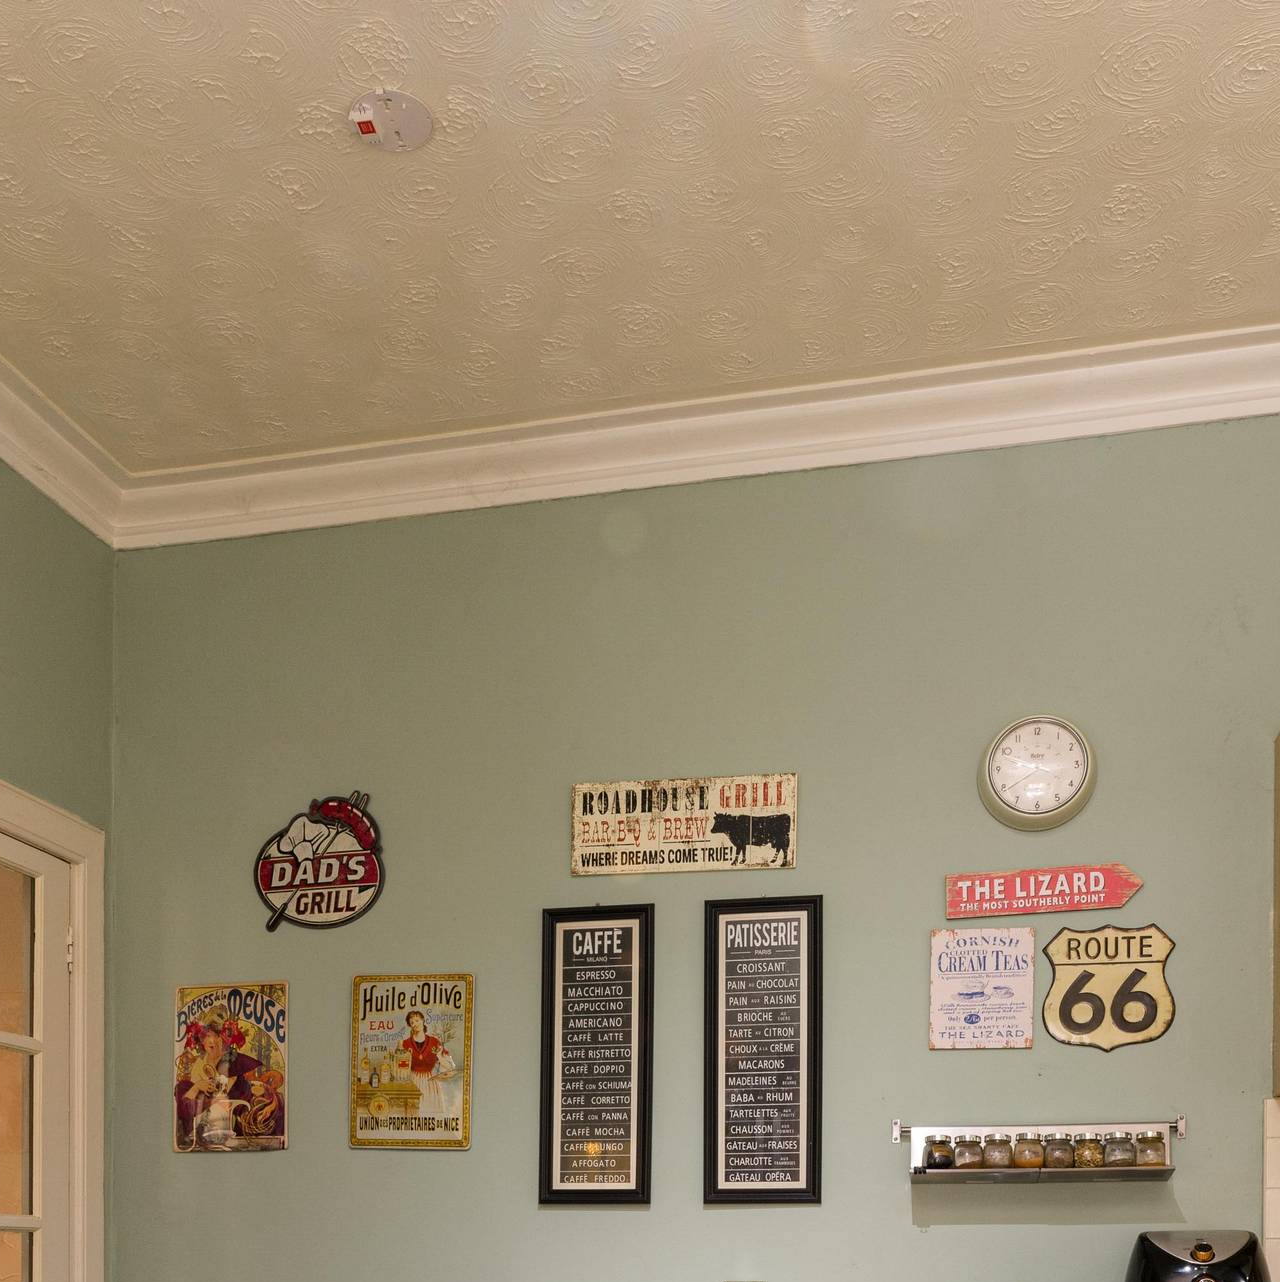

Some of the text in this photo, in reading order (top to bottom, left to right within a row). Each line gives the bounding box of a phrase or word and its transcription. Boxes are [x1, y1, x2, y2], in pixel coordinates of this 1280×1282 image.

[1034, 727, 1041, 736] 12
[1068, 743, 1074, 751] 2
[1074, 760, 1080, 769] 3
[582, 780, 787, 816] ROADHOUSE GRILL
[1055, 793, 1060, 802] 5
[1035, 801, 1040, 809] 6
[647, 818, 657, 841] &
[662, 816, 710, 840] BREW
[581, 846, 733, 867] WHERE DREAMS COME TRUE!
[271, 855, 366, 887] DAD'S
[958, 871, 1106, 901] THE LIZARD
[295, 889, 357, 916] GRILL
[960, 893, 1106, 911] THE MOST SOUTHERLY POINT
[727, 921, 799, 948] PATISSERIE
[572, 928, 623, 955] CAFFÈ
[945, 936, 1020, 949] CORNISH
[1067, 935, 1153, 960] ROUTE
[937, 950, 1029, 973] CREAM TEAS
[736, 962, 786, 973] CROISSANT
[576, 970, 616, 980] ESPRESSO
[727, 980, 746, 990] PAIN
[756, 978, 799, 989] CHOCOLAT
[567, 986, 623, 997] MACCHIATO
[360, 985, 407, 1021] Huile
[729, 997, 748, 1006] PAIN
[763, 994, 797, 1004] RAISINS
[1058, 968, 1158, 1036] 66
[567, 1001, 624, 1012] CAPPUCCINO
[227, 988, 286, 1043] MEUSE
[737, 1012, 773, 1022] BRIOCHE
[369, 1021, 395, 1031] EAU
[568, 1017, 623, 1028] AMERICANO
[598, 1033, 624, 1041] LATTE
[728, 1028, 753, 1038] TARTE
[764, 1027, 794, 1038] CITRON
[939, 1029, 1025, 1039] THE LIZARD
[370, 1045, 388, 1053] EXTRA
[588, 1048, 631, 1058] RISTRETTO
[729, 1045, 758, 1054] CHOUX
[593, 1065, 625, 1074] DOPPIO
[738, 1059, 785, 1070] MACARONS
[598, 1081, 632, 1090] SCHIUMA
[728, 1076, 777, 1086] MADELEINES
[591, 1096, 631, 1105] CORRETTO
[730, 1093, 755, 1103] BABA
[766, 1092, 793, 1101] RHUM
[601, 1112, 629, 1120] PANNA
[729, 1108, 778, 1118] TARTELETTES
[359, 1116, 380, 1131] UNION
[443, 1117, 460, 1132] NICE
[730, 1124, 773, 1134] CHAUSSON
[594, 1127, 625, 1136] MOCHA
[596, 1142, 624, 1151] LUNGO
[726, 1141, 758, 1151] GÂTEAU
[768, 1140, 798, 1150] FRAISES
[572, 1159, 616, 1168] AFFOGATO
[729, 1156, 772, 1166] CHARLOTTE
[594, 1174, 626, 1183] FREDDO
[729, 1171, 792, 1182] GÂTEAU OPÉRA
